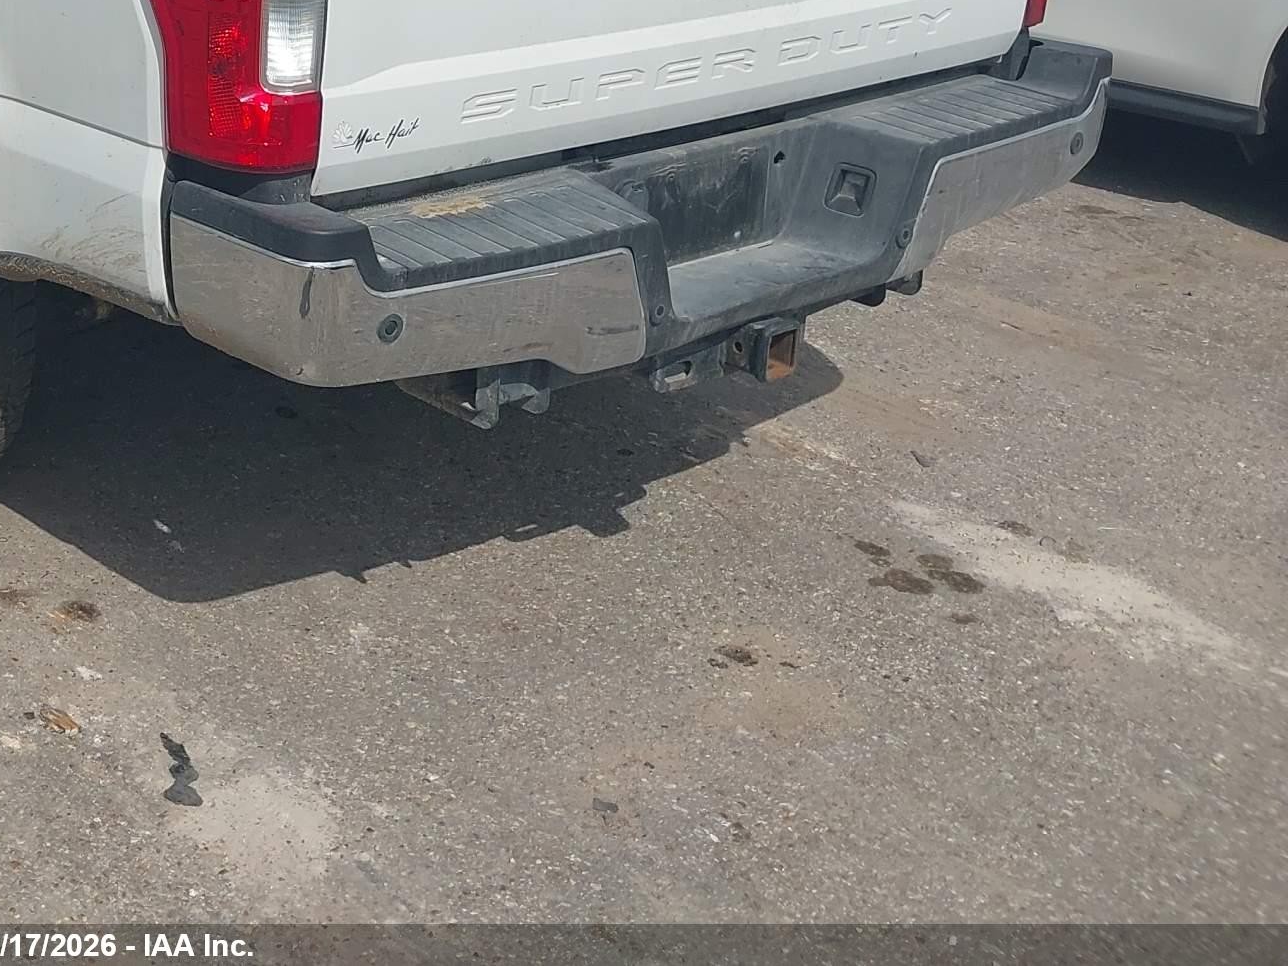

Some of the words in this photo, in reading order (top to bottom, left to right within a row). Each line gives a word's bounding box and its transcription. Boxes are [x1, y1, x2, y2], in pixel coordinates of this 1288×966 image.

[459, 47, 757, 126] SUPER
[778, 6, 952, 67] DUTY
[351, 127, 386, 154] Mac
